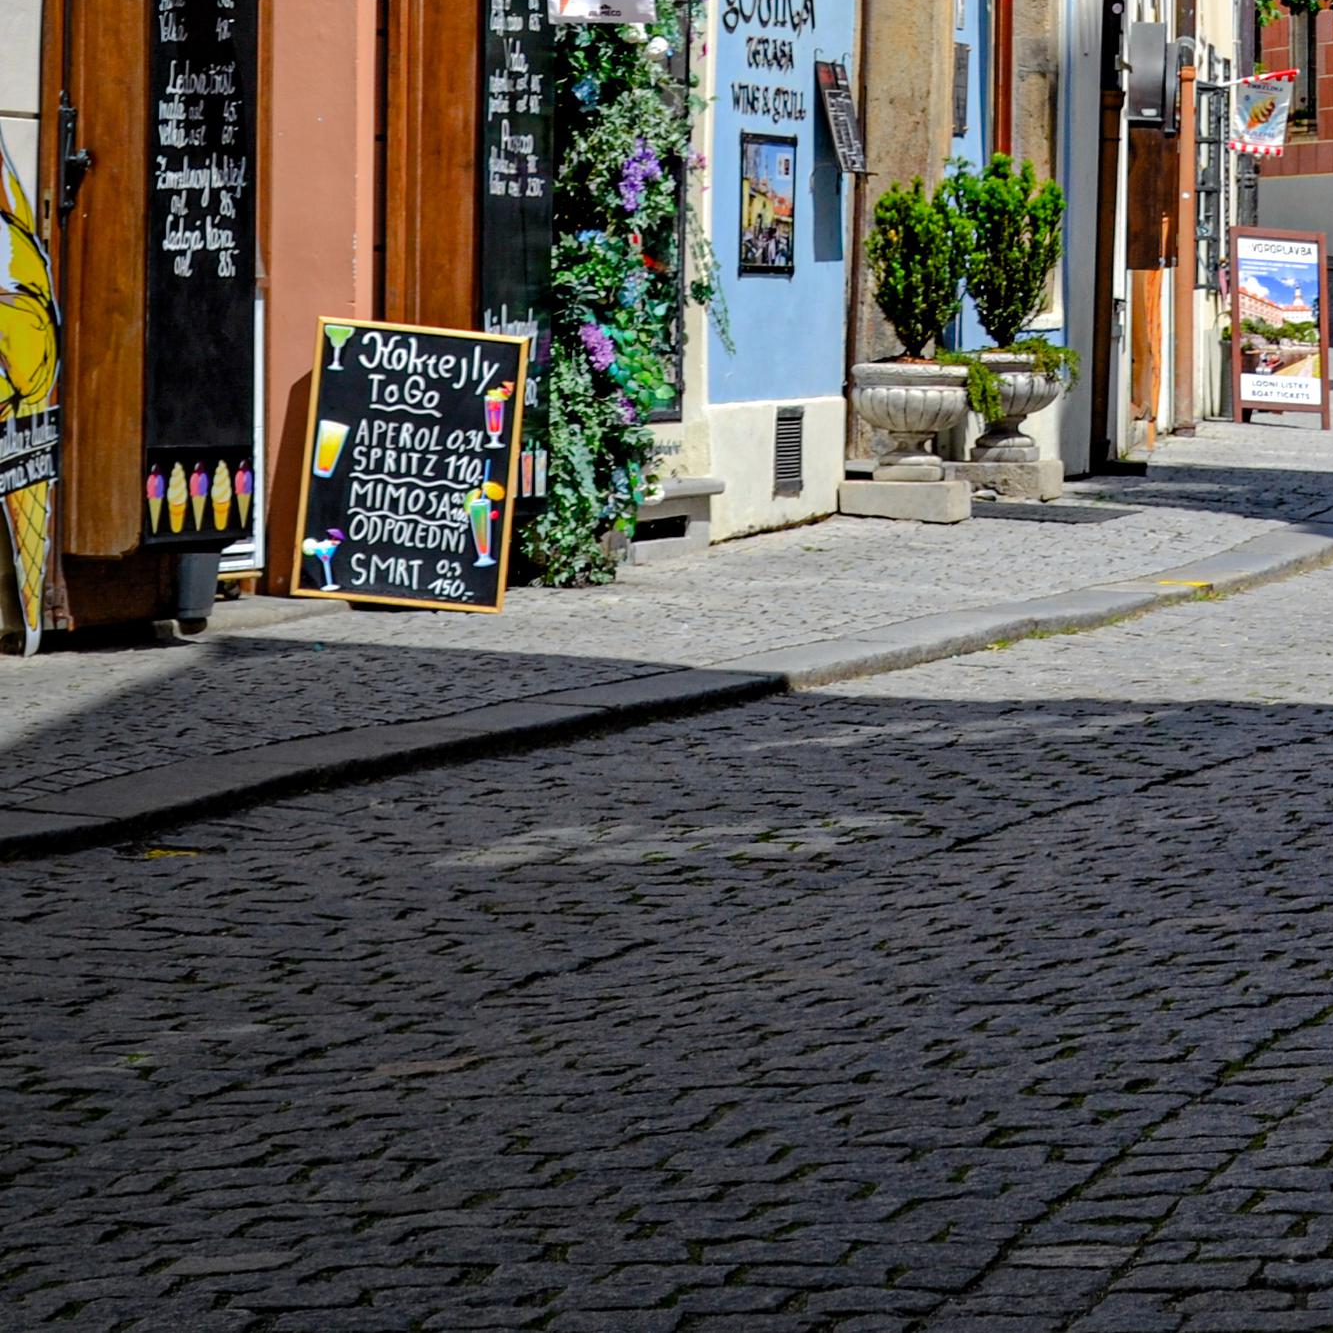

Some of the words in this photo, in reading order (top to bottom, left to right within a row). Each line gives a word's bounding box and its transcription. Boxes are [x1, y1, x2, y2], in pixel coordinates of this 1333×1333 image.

[746, 36, 795, 73] TERASA
[731, 82, 759, 115] WINE
[359, 330, 500, 395] Koktejly
[355, 418, 443, 451] APEROL
[352, 447, 439, 477] SPRITZ
[350, 481, 451, 520] MIMOSA
[351, 554, 423, 590] SMRT
